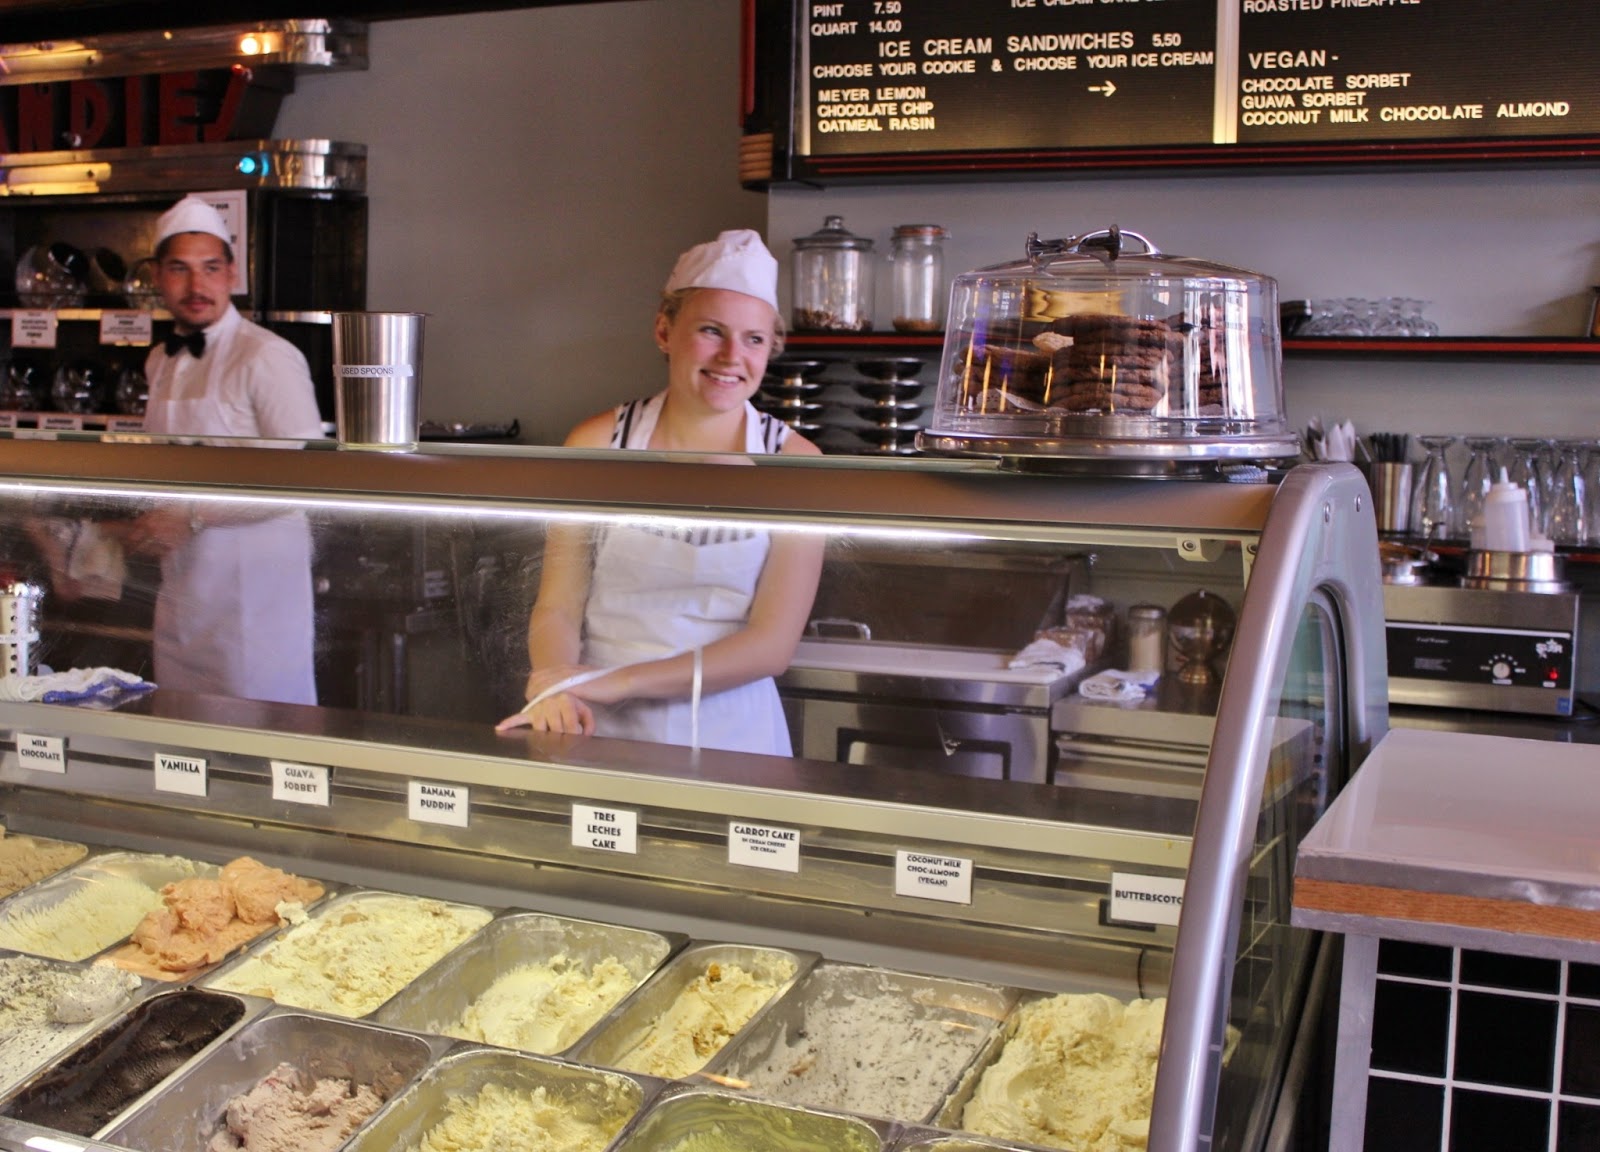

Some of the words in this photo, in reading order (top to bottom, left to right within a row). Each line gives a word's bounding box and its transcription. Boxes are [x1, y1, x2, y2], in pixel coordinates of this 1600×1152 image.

[813, 3, 842, 17] PINT
[874, 2, 901, 14] 7.50
[1243, 0, 1323, 13] ROASTED
[811, 22, 858, 36] QUART
[869, 20, 901, 33] 14.00
[879, 41, 911, 58] ICE
[924, 38, 992, 56] CREAM
[1006, 32, 1134, 53] SANDWICHES
[1152, 33, 1181, 48] 5.50
[813, 64, 873, 79] CHOOSE
[879, 62, 917, 76] YOUR
[922, 59, 976, 74] COOKIE
[991, 58, 1002, 72] &
[1014, 56, 1077, 71] CHOOSE
[1087, 54, 1128, 69] YOUR
[1131, 53, 1158, 68] ICE
[1161, 51, 1214, 66] CREAM
[1242, 76, 1334, 93] CHOCOLATE
[1346, 73, 1411, 89] SORBET
[818, 88, 869, 103] MEYER
[876, 86, 926, 101] LEMON
[1242, 95, 1294, 110] GUAVA
[1302, 92, 1366, 108] SORBET
[817, 103, 898, 118] CHOCOLATE
[901, 102, 934, 116] CHIP
[1242, 110, 1320, 126] COCONUT
[1330, 109, 1368, 123] MILK
[1380, 105, 1483, 122] CHOCOLATE
[1497, 102, 1570, 118] ALMOND
[818, 118, 882, 133] OATMEAL
[889, 117, 935, 131] RASIN
[341, 367, 359, 375] USED
[360, 367, 394, 375] SPOONS
[32, 740, 48, 748] MILK
[21, 748, 60, 761] CHOCOLATE
[160, 759, 200, 774] VANILLA
[285, 768, 315, 780] GUAVA
[284, 782, 317, 794] SORBET
[421, 786, 456, 798] BANANA
[594, 812, 616, 822] TRES
[587, 824, 622, 837] LECHES
[734, 826, 770, 838] CARROT
[772, 830, 795, 841] CAKE
[592, 838, 616, 850] CAKE
[907, 855, 942, 866] COCONUT
[944, 860, 962, 868] MILK
[907, 865, 960, 878] CHOC-ALMOND
[918, 876, 948, 887] (VEGAN)
